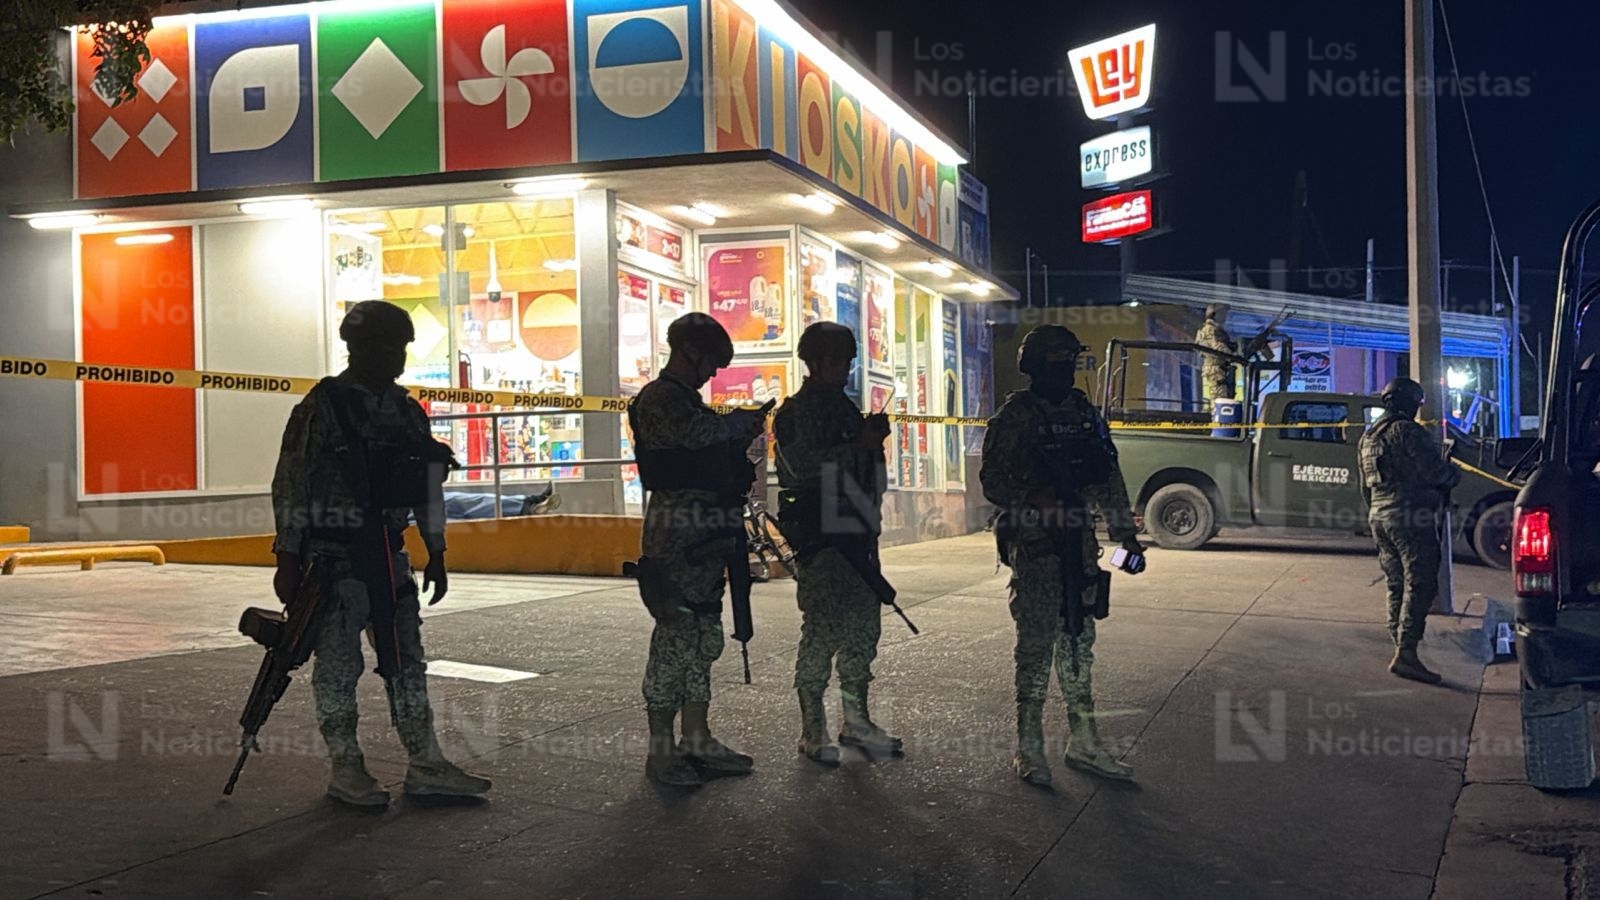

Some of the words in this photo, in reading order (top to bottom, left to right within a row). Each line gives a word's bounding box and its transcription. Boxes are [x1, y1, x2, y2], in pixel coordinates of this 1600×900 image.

[1080, 40, 1145, 107] Ley
[711, 1, 916, 227] KIOSKO
[1085, 140, 1146, 172] express
[1, 360, 48, 376] BIDO
[76, 365, 175, 385] PROHIBIDO
[201, 375, 291, 391] PROHIBIDO
[419, 389, 494, 404] PROHIBIDO
[514, 395, 583, 408] PROHIBIDO
[1292, 464, 1349, 477] EJÉRCITO
[1293, 474, 1348, 484] MEXICANO
